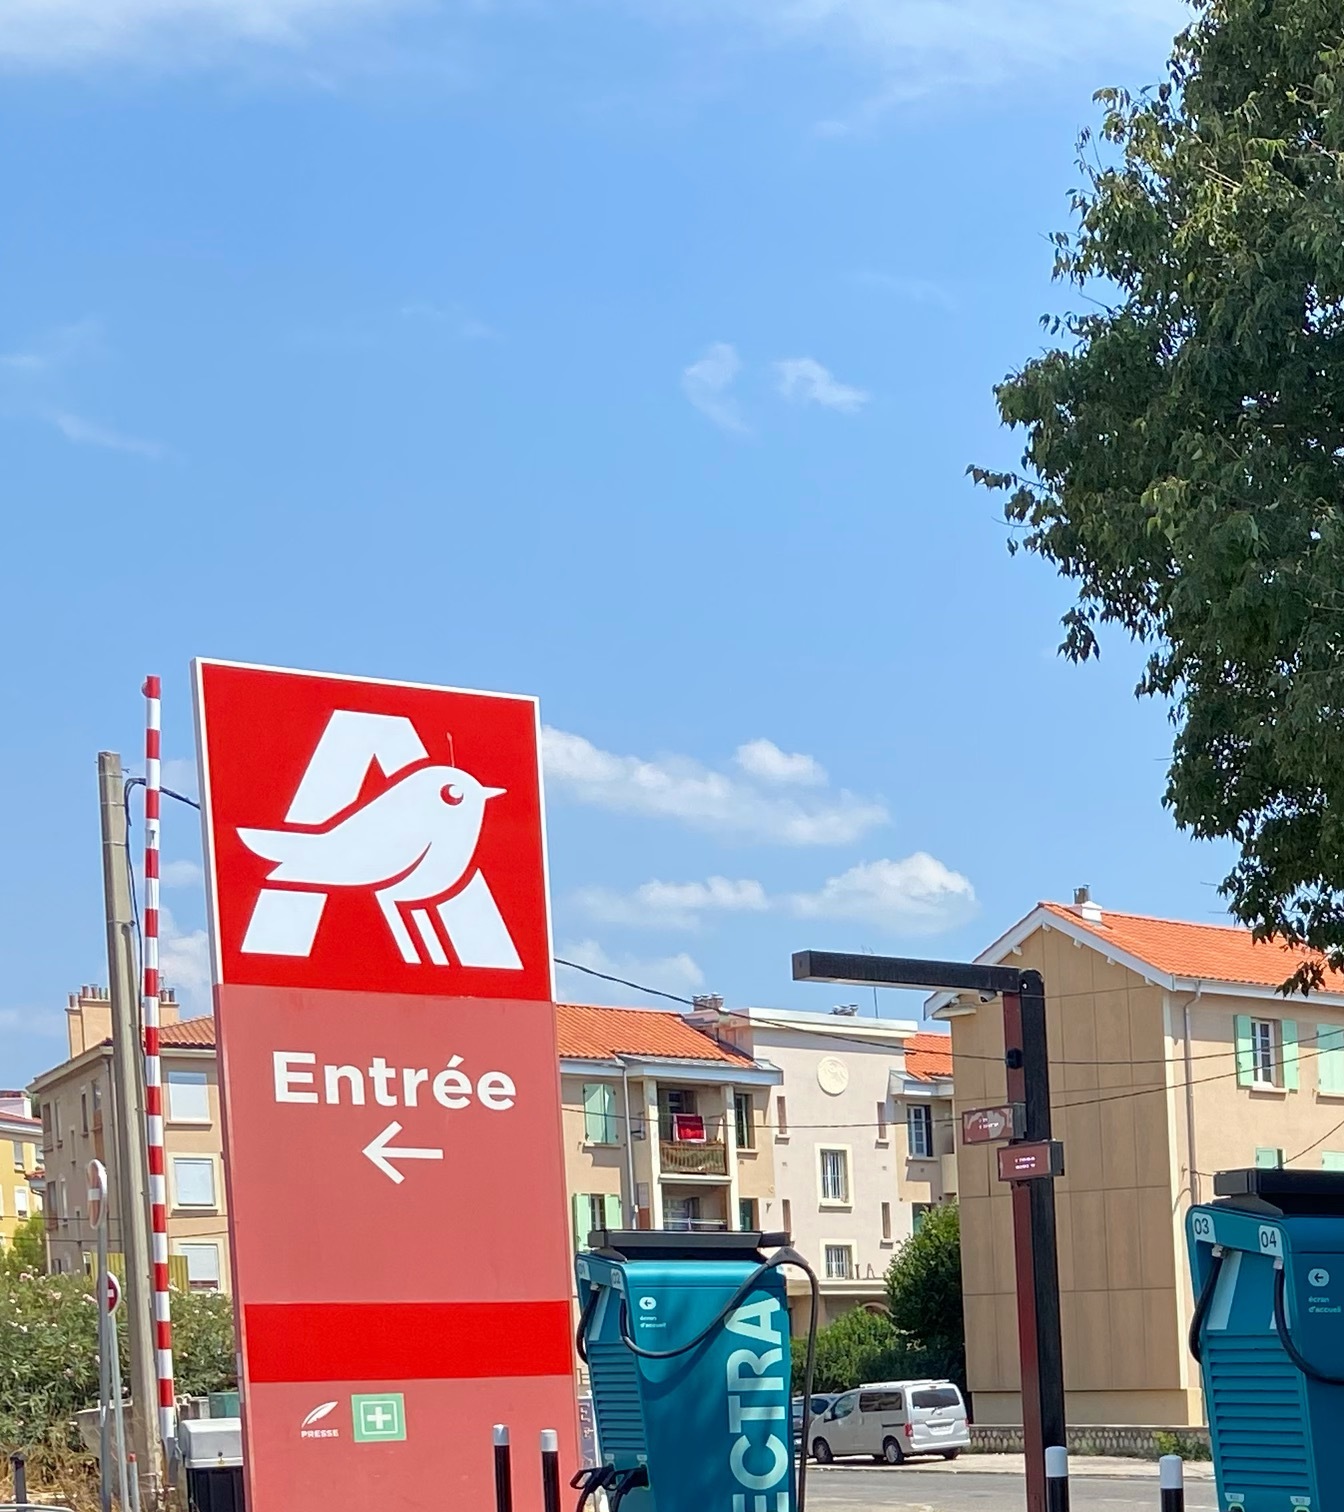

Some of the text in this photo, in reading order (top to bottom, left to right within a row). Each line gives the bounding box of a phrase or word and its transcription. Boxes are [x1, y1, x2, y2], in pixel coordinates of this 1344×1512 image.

[272, 1050, 517, 1111] Entrée
[1193, 1217, 1210, 1235] 03
[1260, 1230, 1278, 1249] 04
[300, 1428, 340, 1438] PRESSE
